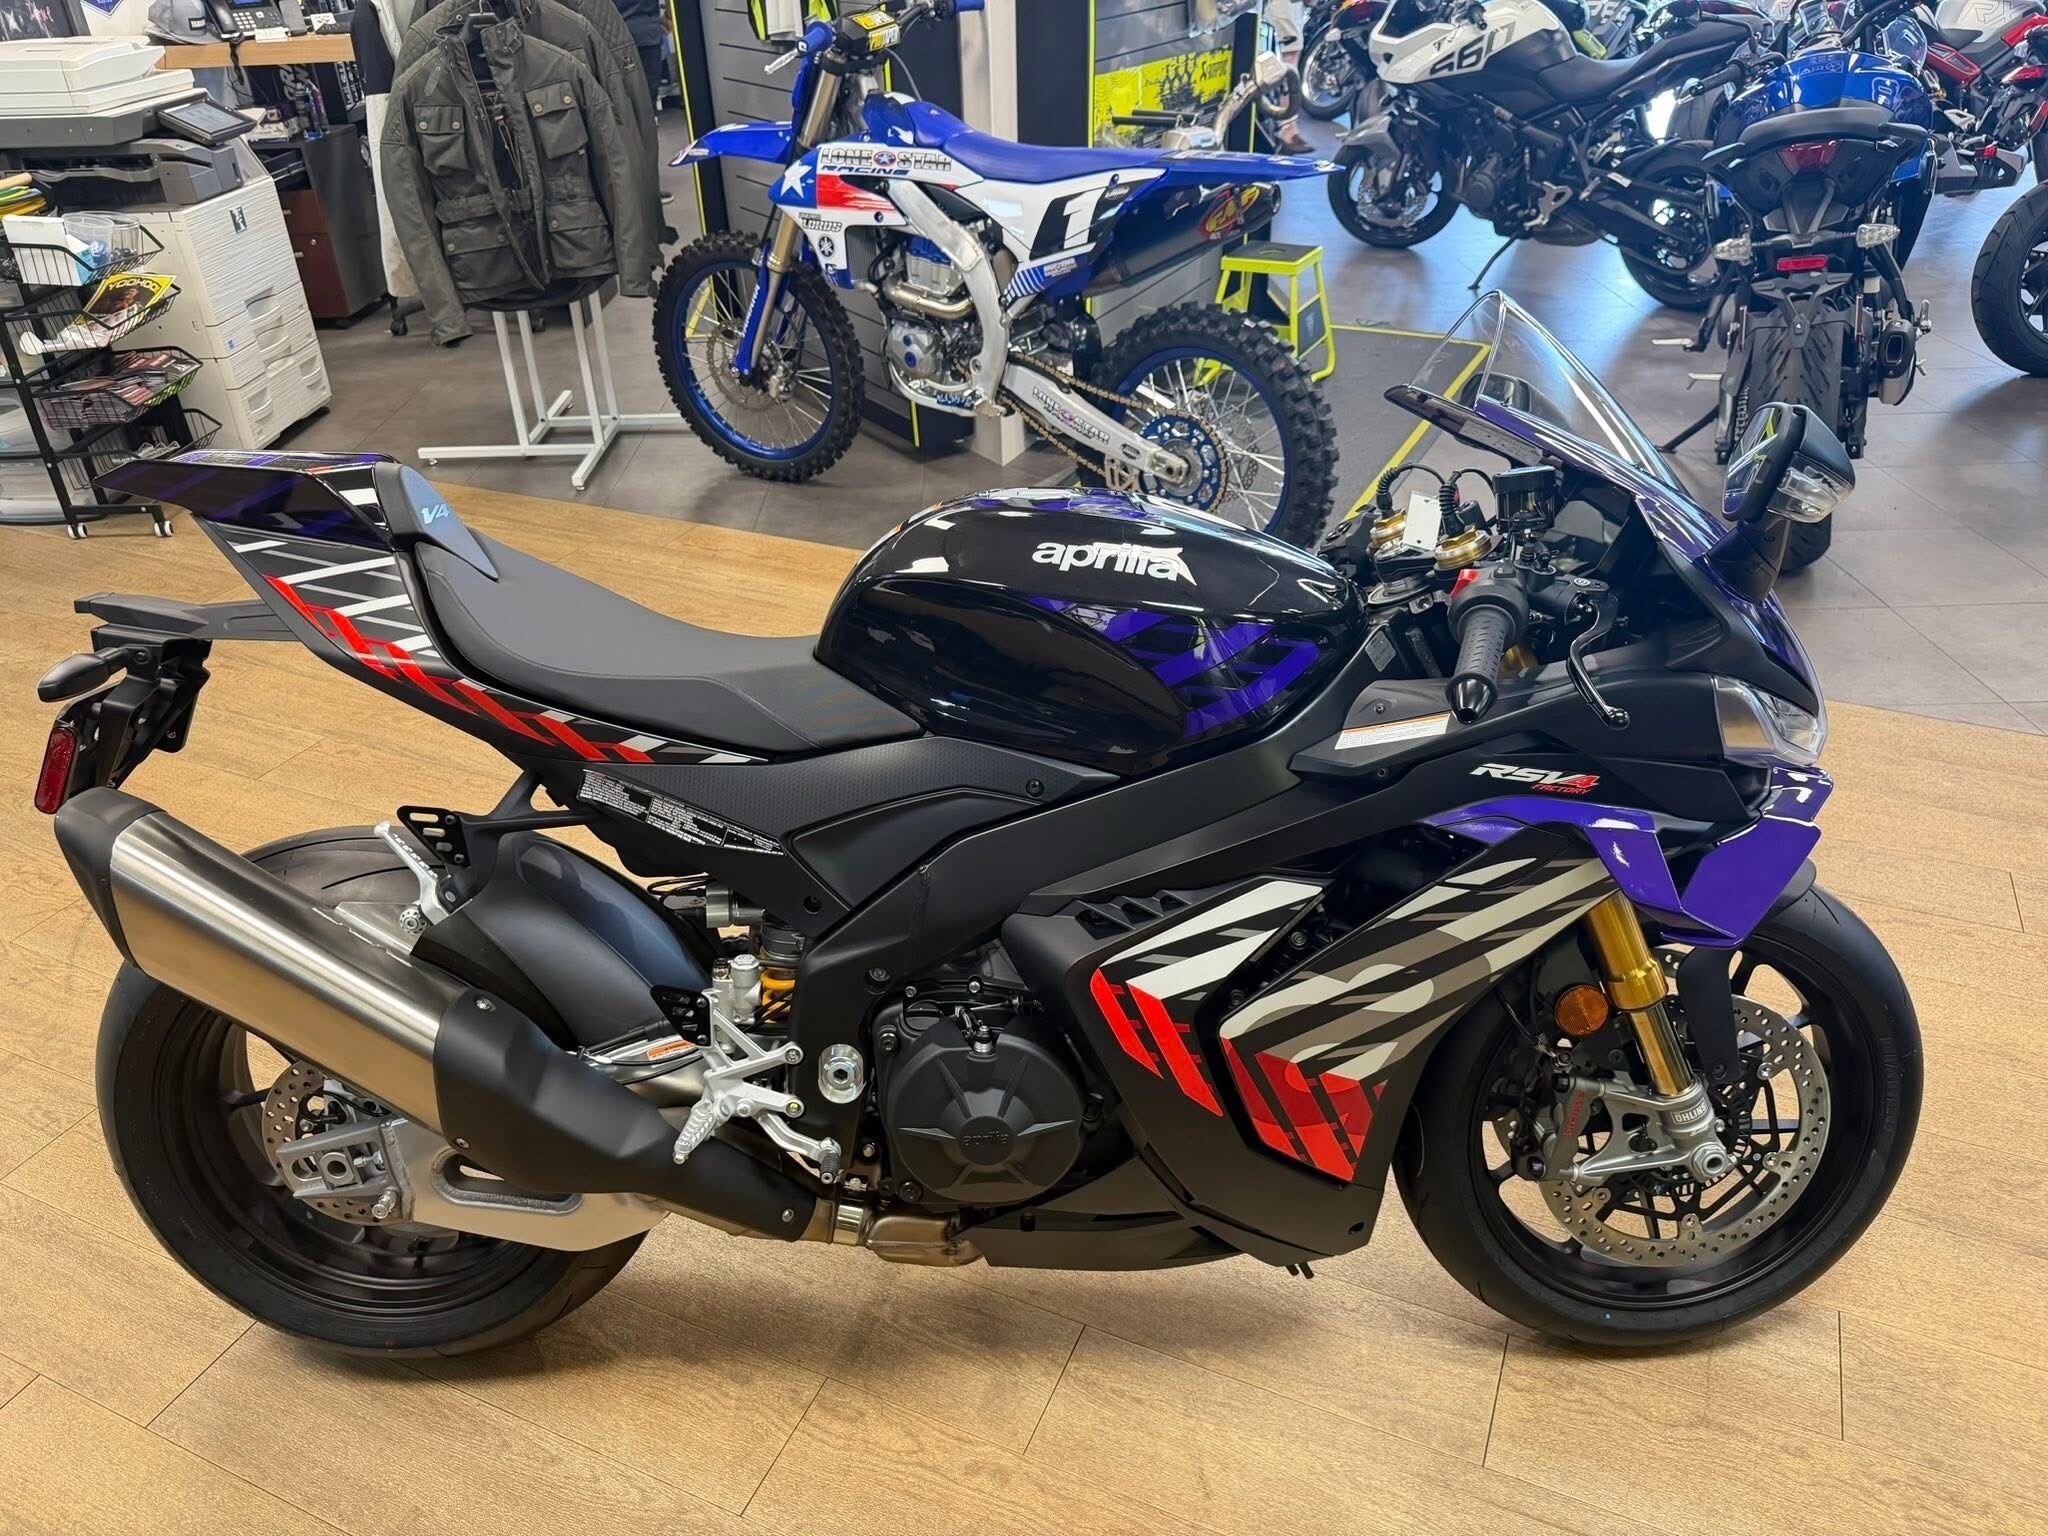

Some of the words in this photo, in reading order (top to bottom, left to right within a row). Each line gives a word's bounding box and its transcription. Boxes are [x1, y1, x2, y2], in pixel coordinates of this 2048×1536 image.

[820, 149, 873, 166] LONE
[897, 152, 952, 172] STAR
[820, 165, 911, 176] RACING
[1062, 186, 1107, 250] 1
[1032, 541, 1188, 585] aprilia
[1469, 763, 1600, 789] RSV4
[1531, 783, 1593, 795] FACTORY
